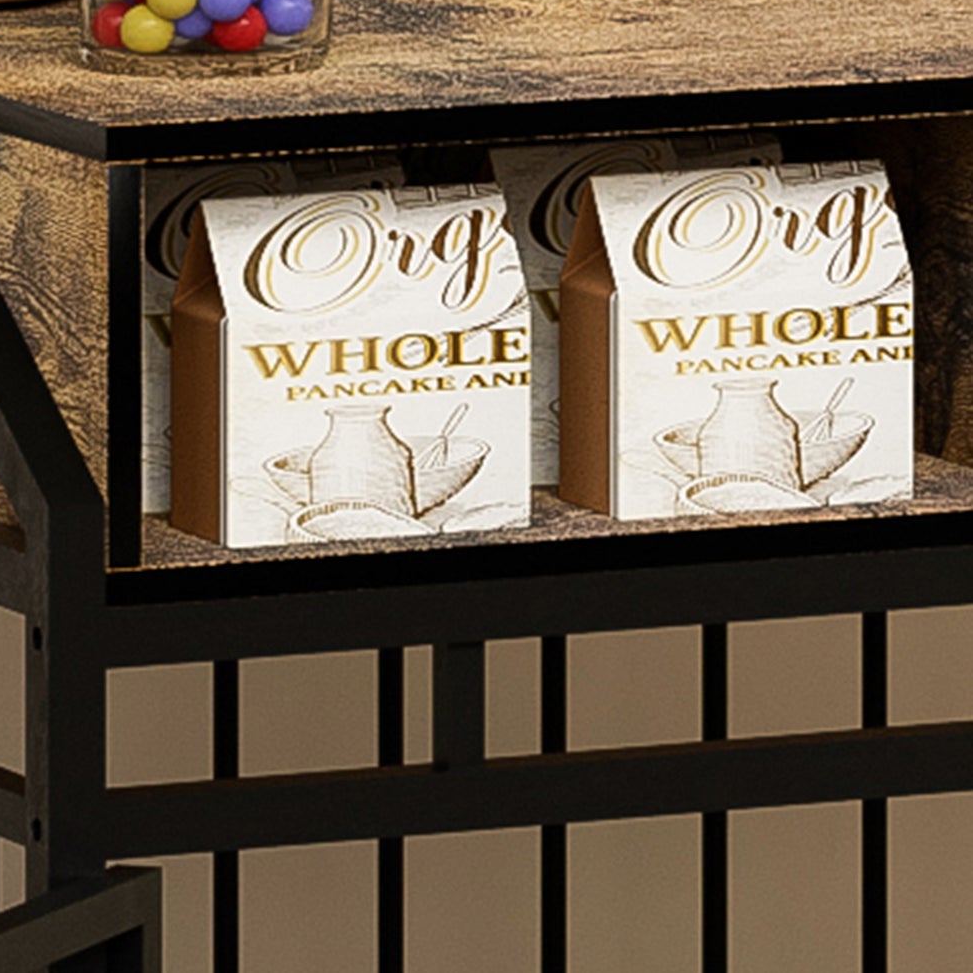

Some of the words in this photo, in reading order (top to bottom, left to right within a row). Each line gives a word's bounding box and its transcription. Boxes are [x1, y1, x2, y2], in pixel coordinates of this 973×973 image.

[244, 194, 513, 314] Org
[633, 171, 896, 289] Org
[634, 303, 912, 352] WHOLE
[242, 328, 530, 378] WHOLE
[676, 351, 841, 374] PANCAKE
[287, 377, 456, 400] PANCAKE
